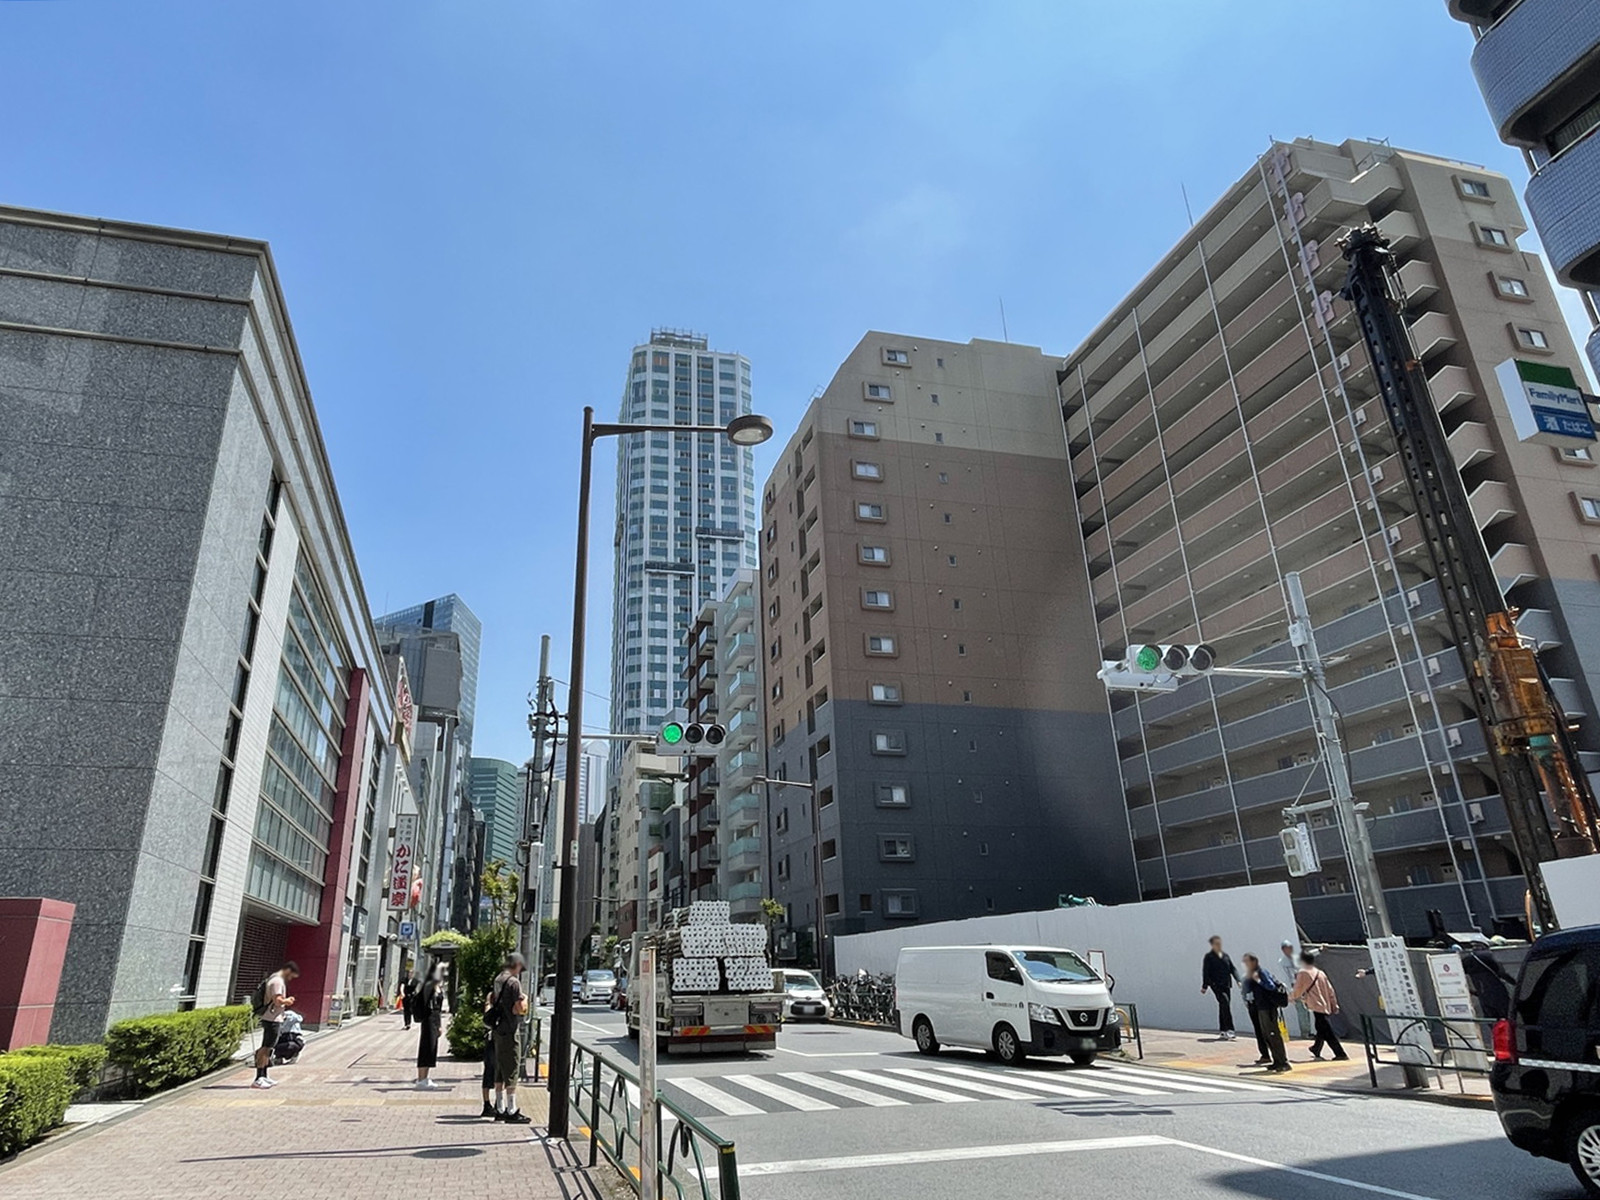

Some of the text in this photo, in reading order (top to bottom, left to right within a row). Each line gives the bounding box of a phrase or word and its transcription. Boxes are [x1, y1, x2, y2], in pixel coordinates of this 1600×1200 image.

[1528, 387, 1582, 405] FamilyMart
[1562, 419, 1592, 434] たばこ
[391, 844, 411, 907] かに道楽
